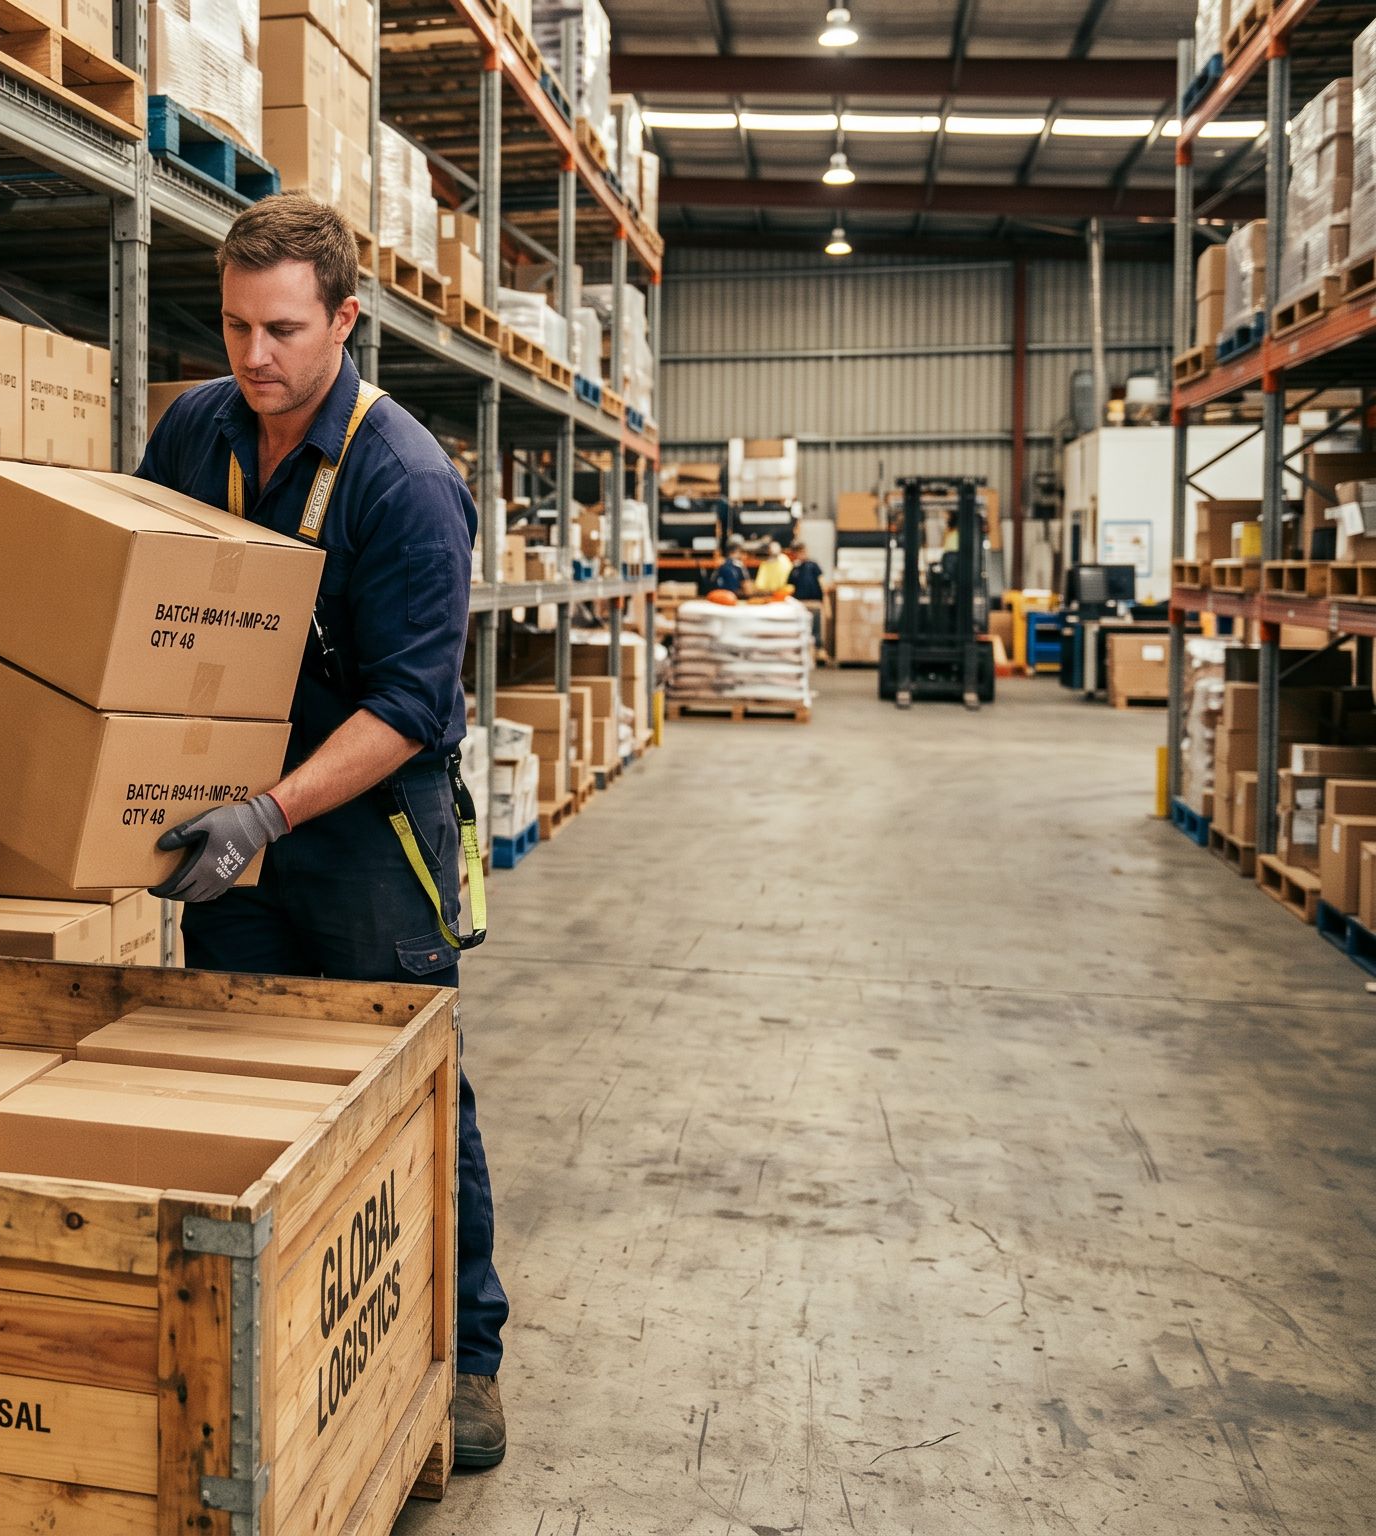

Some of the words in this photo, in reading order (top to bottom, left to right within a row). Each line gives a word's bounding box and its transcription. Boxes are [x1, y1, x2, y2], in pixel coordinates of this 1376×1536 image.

[155, 604, 200, 623] BATCH
[151, 629, 178, 648] QTY
[179, 632, 195, 649] 48
[126, 783, 169, 801] BATCH
[171, 784, 249, 802] #9411-IMP-22
[122, 808, 149, 825] QTY
[150, 808, 166, 825] 48
[320, 1169, 400, 1340] GLOBAL
[317, 1258, 400, 1437] LOGISTICS
